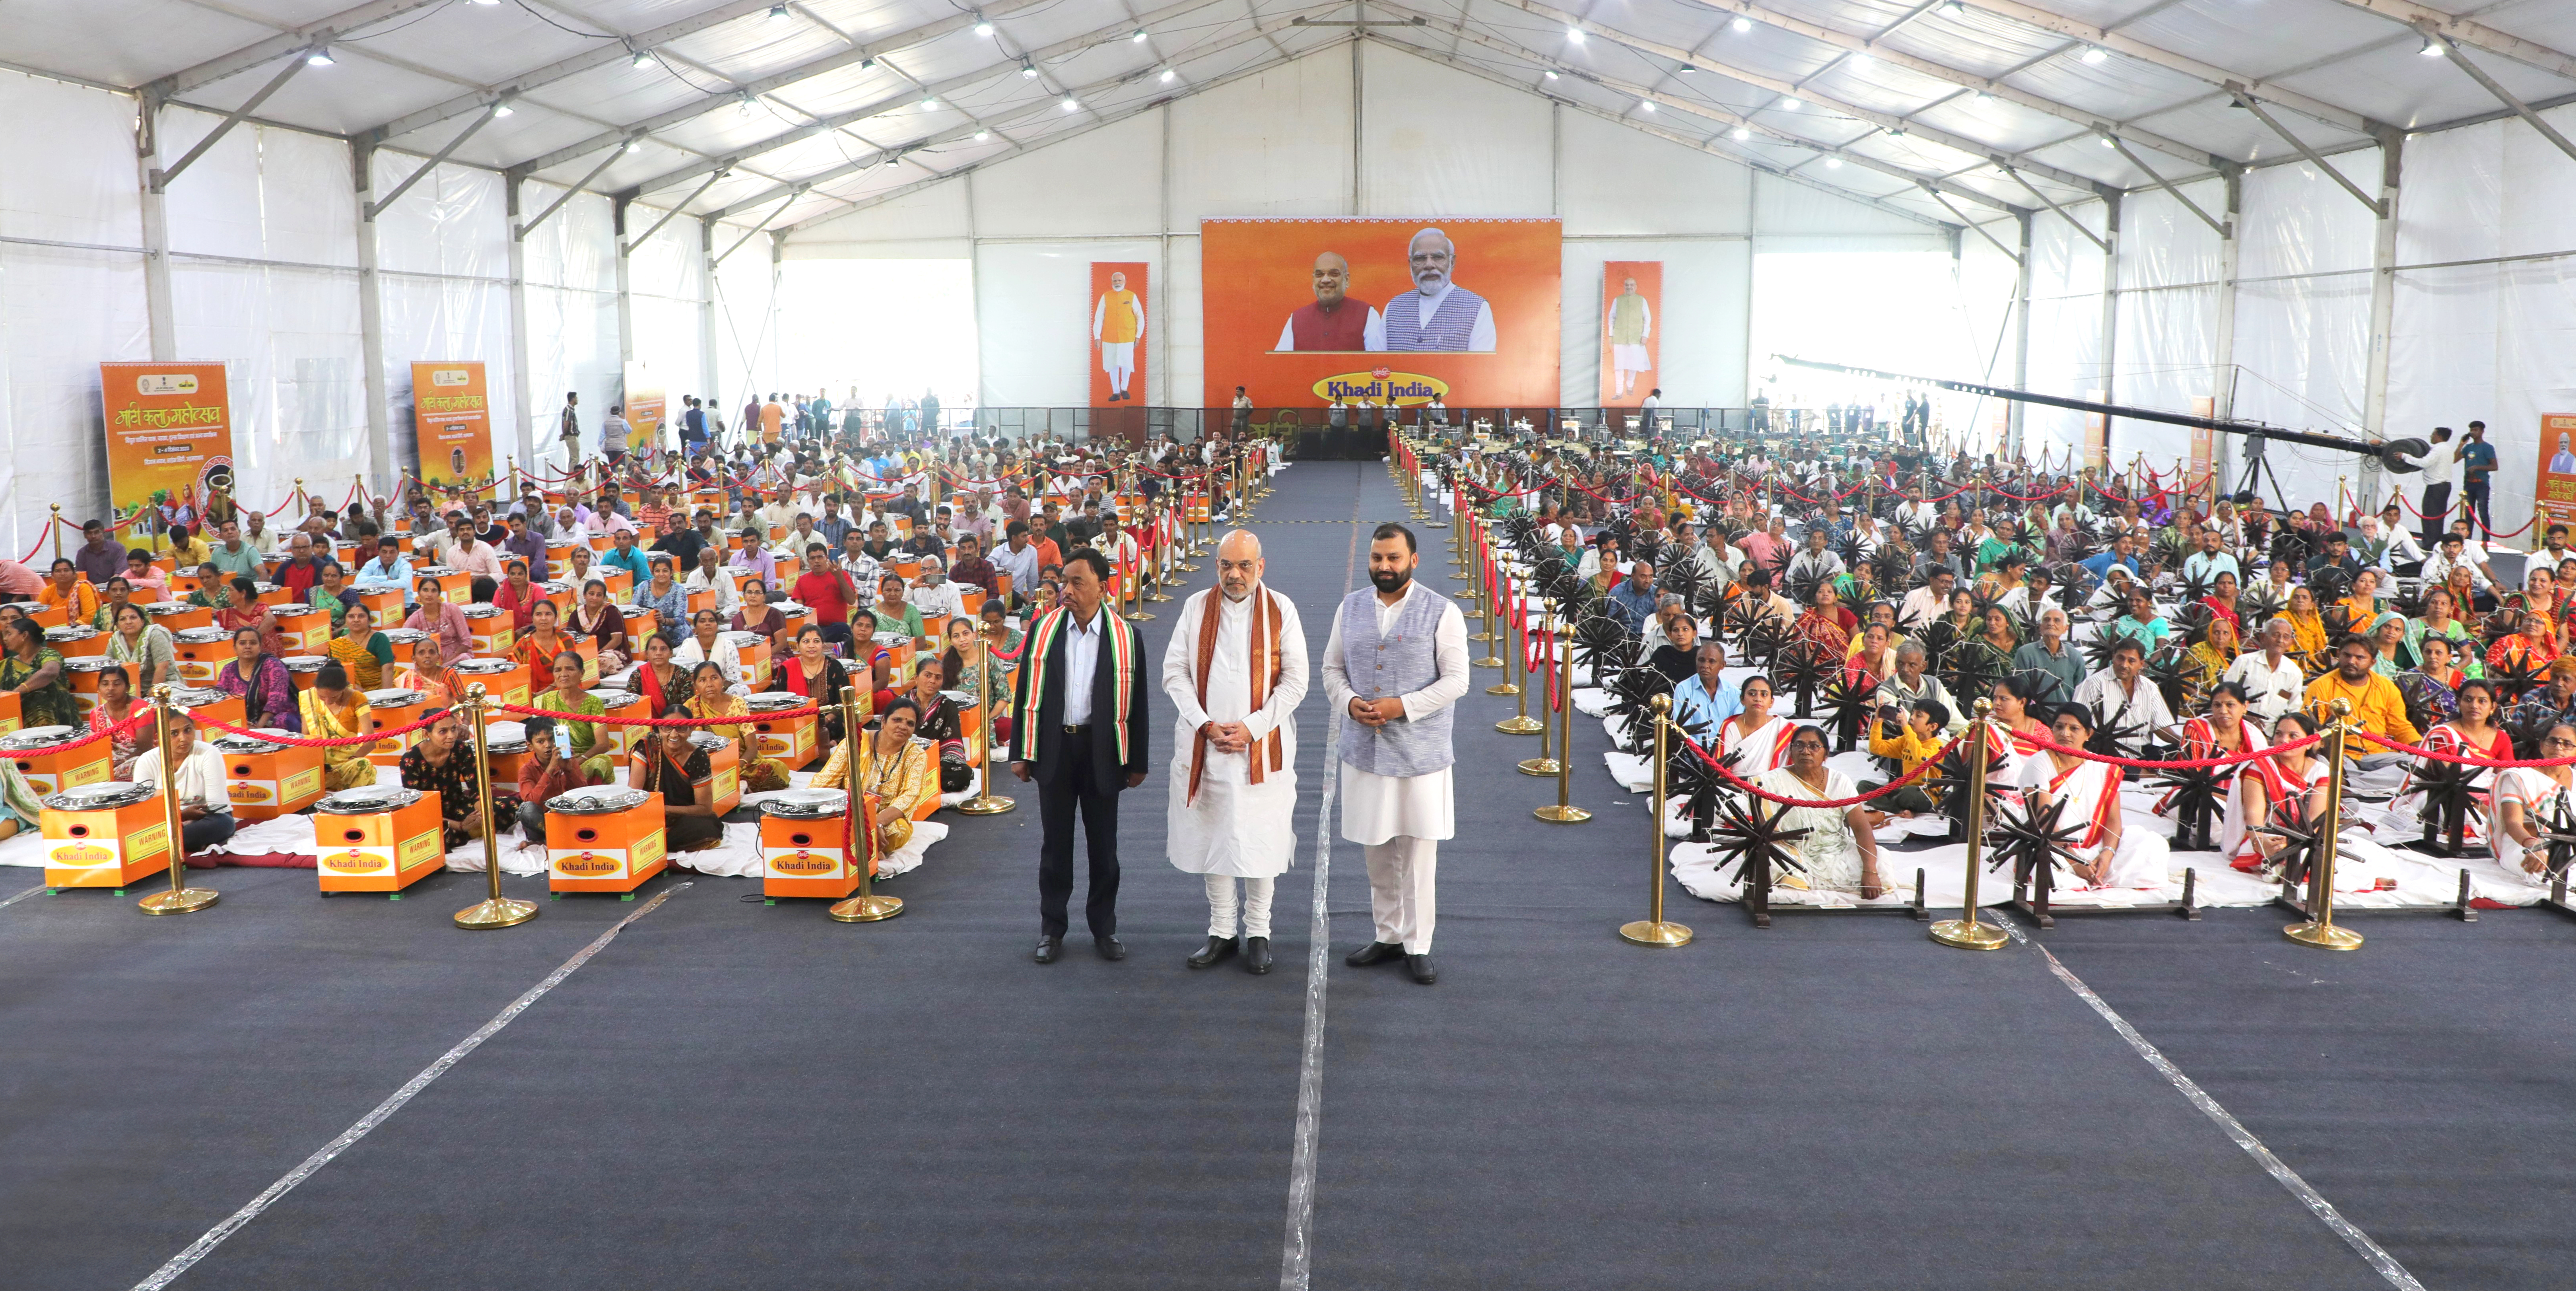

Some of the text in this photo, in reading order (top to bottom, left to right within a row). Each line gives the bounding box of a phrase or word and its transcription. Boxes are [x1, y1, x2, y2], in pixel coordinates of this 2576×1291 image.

[1327, 381, 1433, 397] Khadi India
[142, 409, 171, 428] कला
[170, 401, 221, 425] महोत्सव
[74, 767, 99, 782] WARNING
[290, 776, 311, 789] WARNING
[138, 829, 166, 846] WARNING
[410, 838, 431, 854] WARNING
[639, 839, 657, 856] WARNING
[777, 861, 804, 869] Khadi
